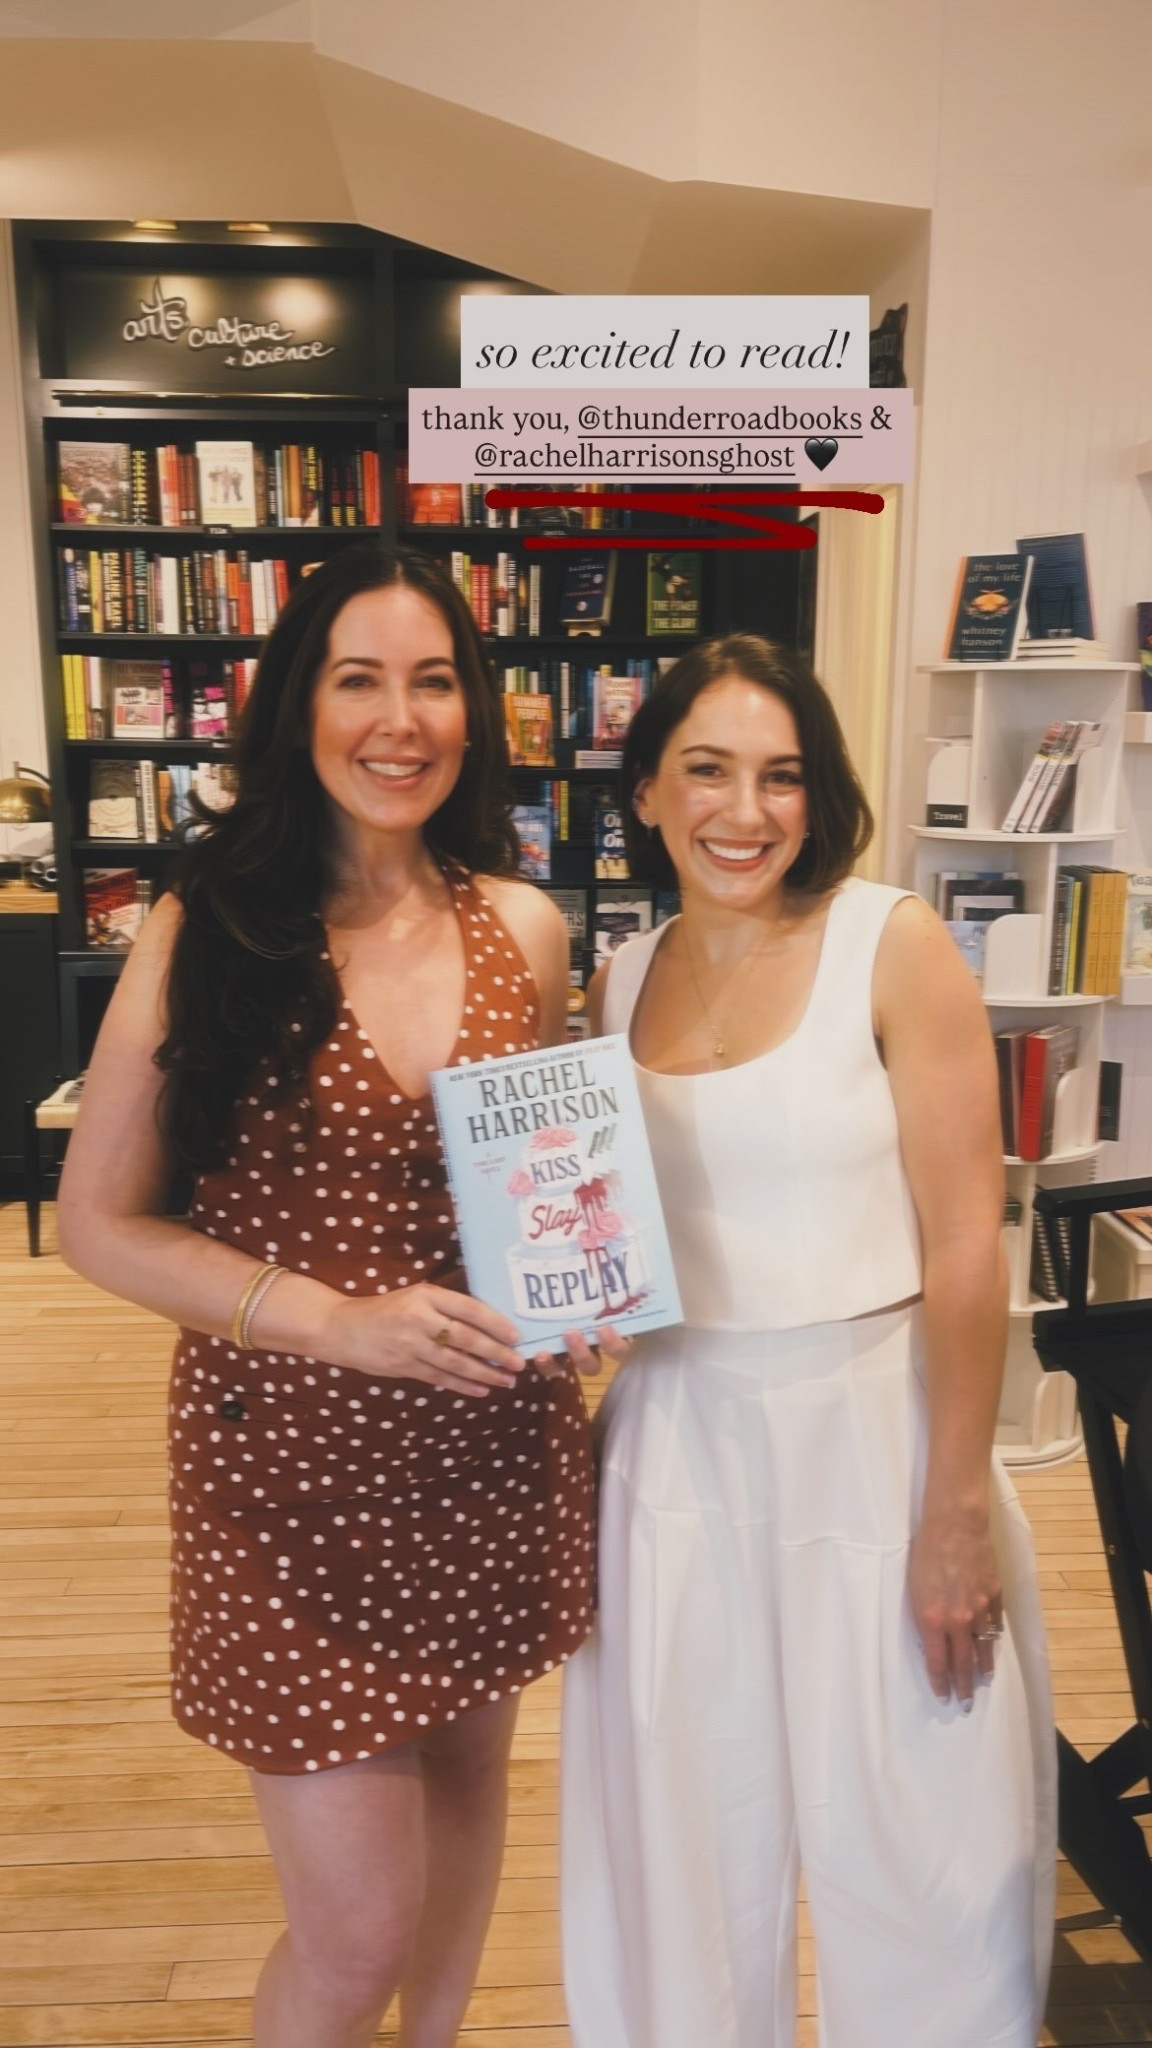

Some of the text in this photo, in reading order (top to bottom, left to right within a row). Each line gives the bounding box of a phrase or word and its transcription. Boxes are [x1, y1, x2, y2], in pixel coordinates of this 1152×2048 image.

[122, 274, 188, 342] arts
[188, 317, 296, 348] culture
[241, 341, 337, 367] science
[982, 575, 999, 584] my
[995, 562, 1020, 571] love
[933, 811, 964, 821] Travel
[478, 1060, 596, 1108] RACHEL
[466, 1086, 621, 1144] HARRISON
[530, 1154, 582, 1186] KISS
[527, 1204, 585, 1241] Slay
[522, 1250, 631, 1310] REPLAY
